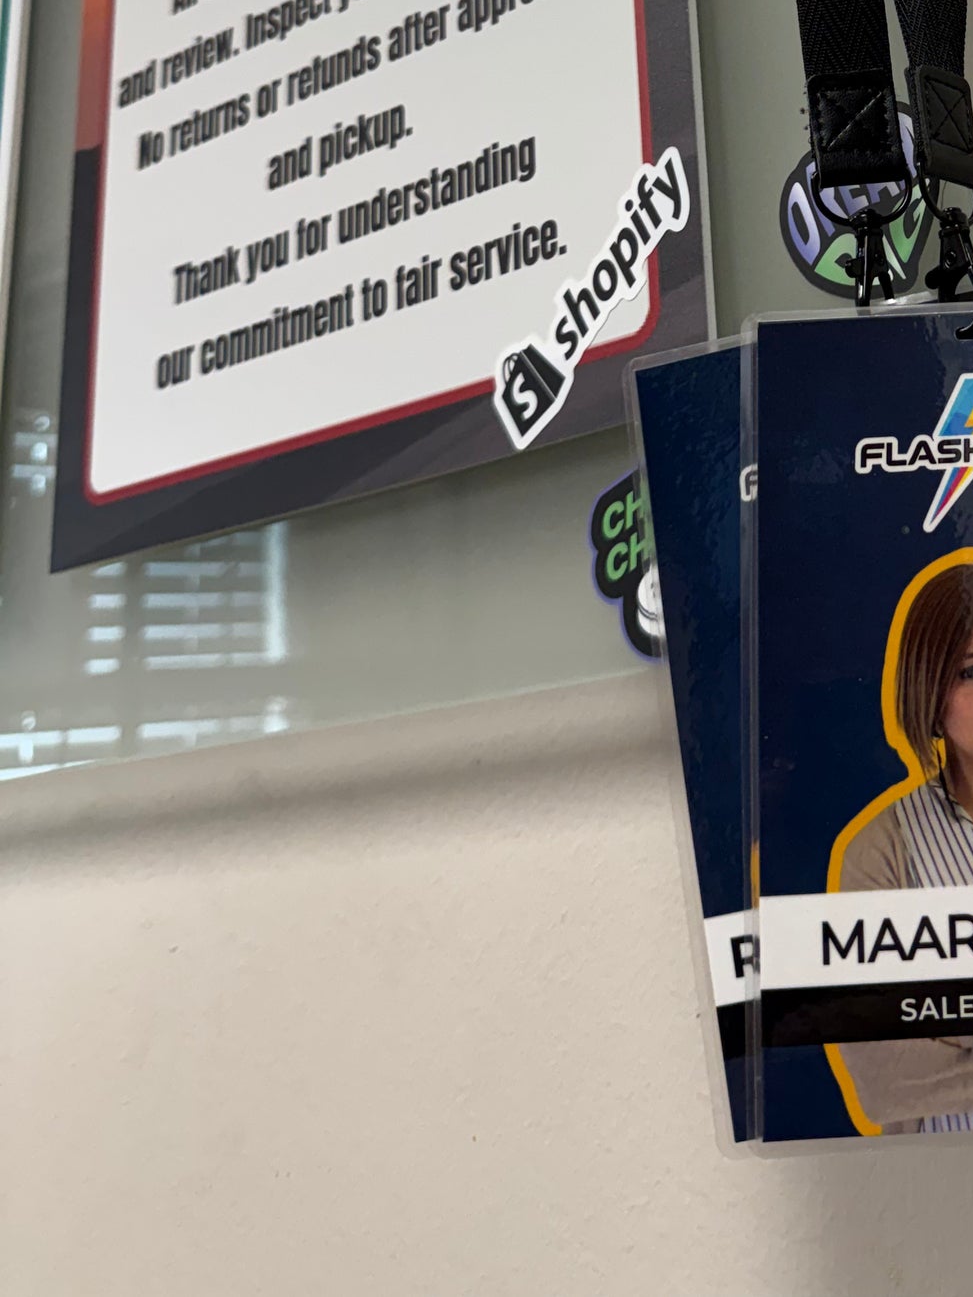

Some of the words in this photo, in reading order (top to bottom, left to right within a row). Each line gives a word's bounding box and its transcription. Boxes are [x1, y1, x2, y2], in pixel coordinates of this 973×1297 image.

[118, 59, 157, 109] and
[160, 27, 239, 90] review.
[138, 130, 165, 171] No
[170, 93, 250, 157] returns
[257, 79, 282, 119] or
[287, 35, 381, 106] refunds
[388, 4, 450, 62] after
[268, 136, 313, 191] and
[319, 104, 413, 177] pickup.
[157, 345, 195, 389] our
[199, 284, 354, 375] commitment
[362, 278, 388, 322] to
[396, 255, 442, 310] fair
[450, 219, 567, 292] service.
[174, 246, 241, 305] Thank
[245, 230, 290, 285] you
[297, 215, 332, 261] for
[339, 136, 537, 243] understanding
[556, 157, 683, 361] shopify
